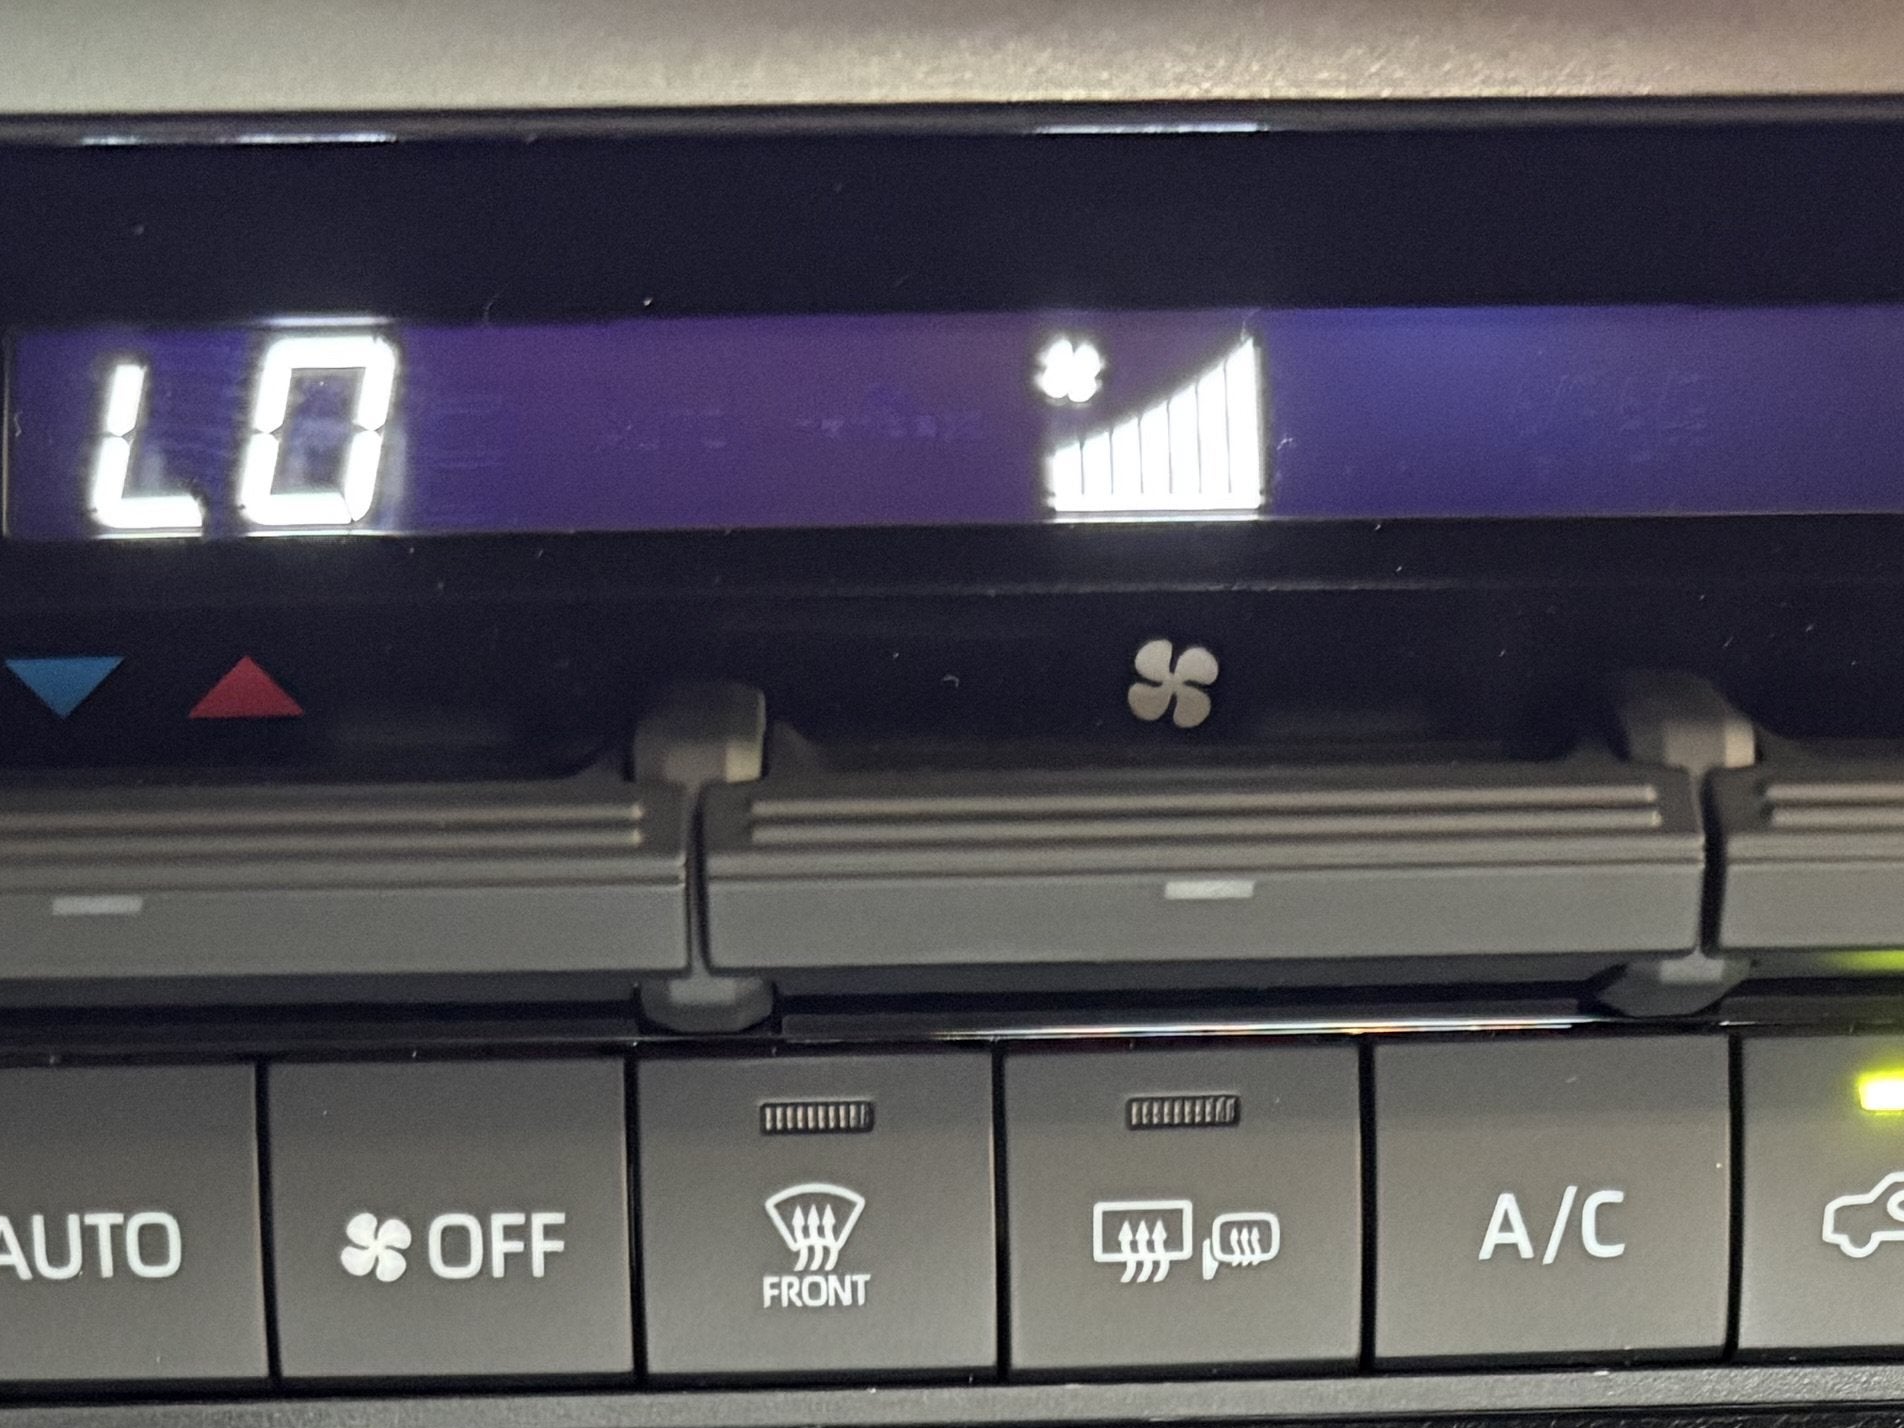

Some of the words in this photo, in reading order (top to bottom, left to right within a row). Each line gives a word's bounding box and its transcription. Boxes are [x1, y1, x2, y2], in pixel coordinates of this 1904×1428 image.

[426, 1210, 566, 1280] OFF
[1476, 1183, 1627, 1266] A/C
[761, 1272, 872, 1309] FRONT
